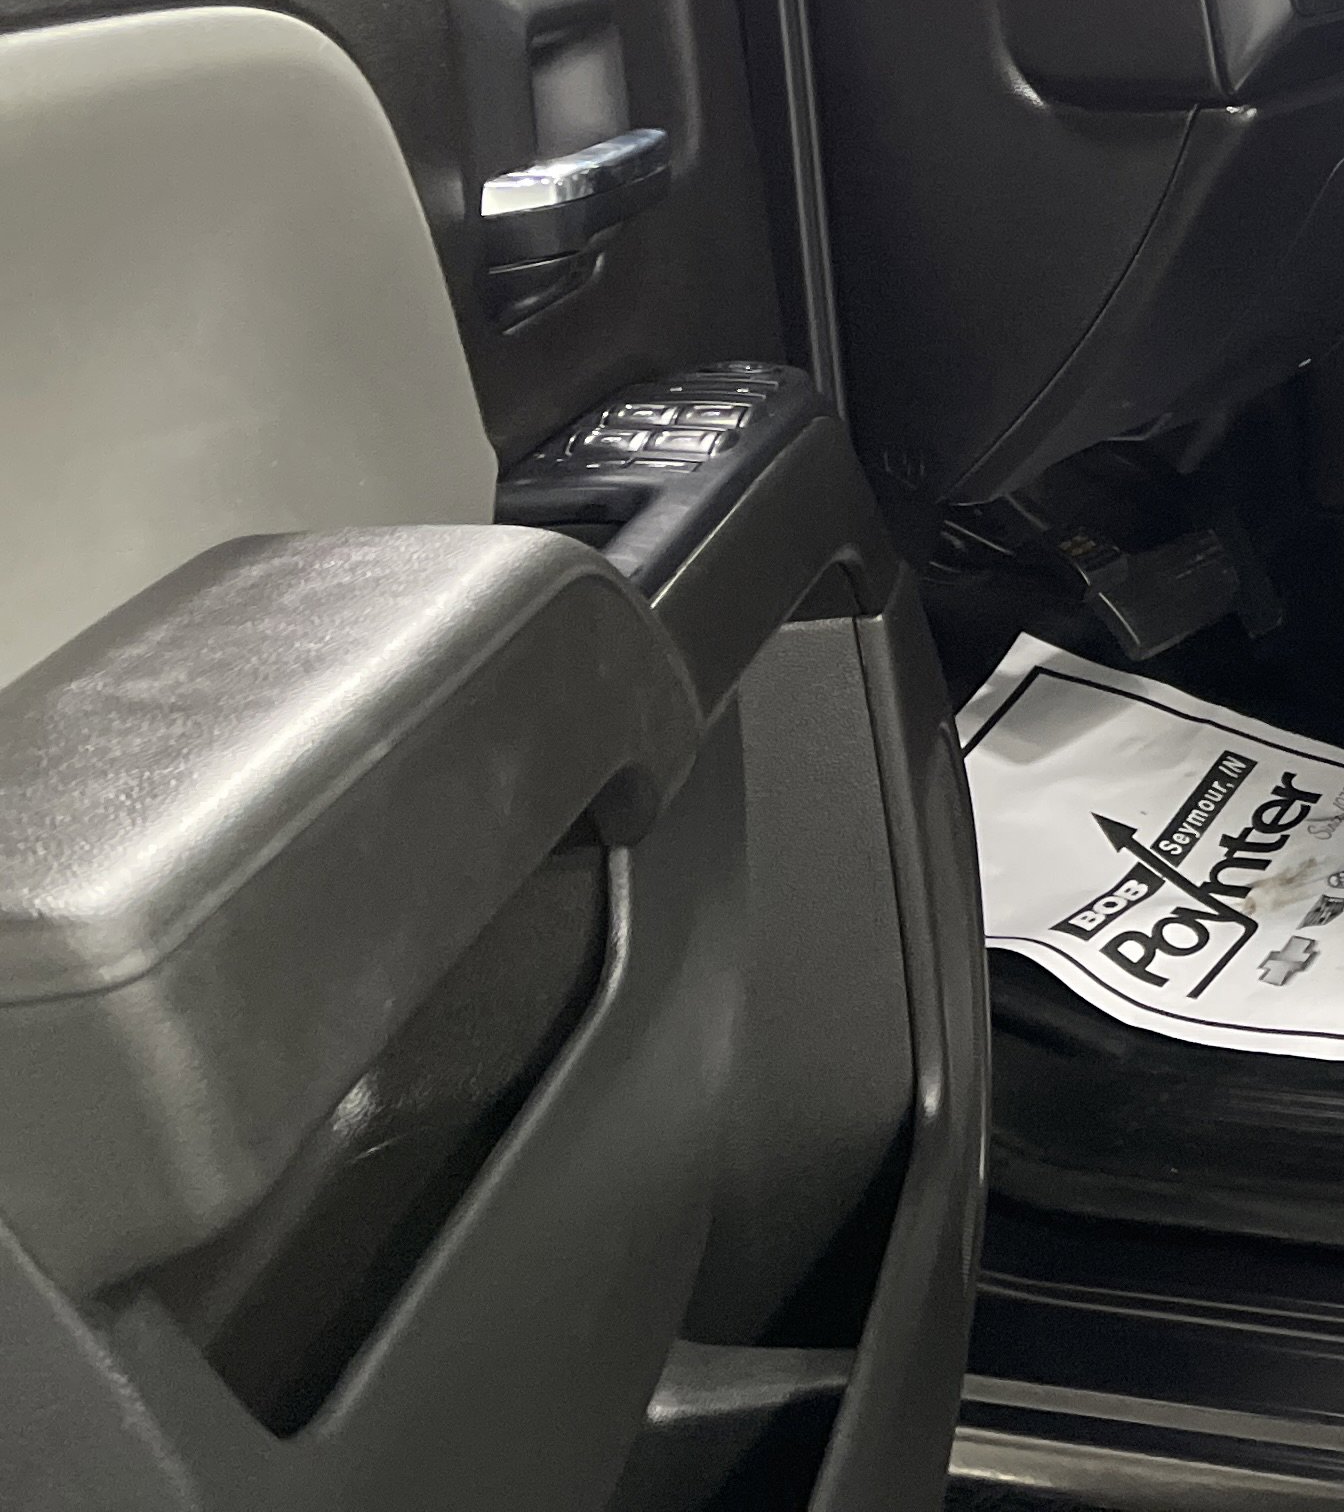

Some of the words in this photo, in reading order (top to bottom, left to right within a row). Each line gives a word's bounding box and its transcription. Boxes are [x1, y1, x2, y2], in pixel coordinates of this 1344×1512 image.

[1158, 778, 1235, 856] Seymour,
[1218, 755, 1248, 779] IN
[1067, 879, 1149, 932] BOB
[1099, 771, 1323, 999] Poynter
